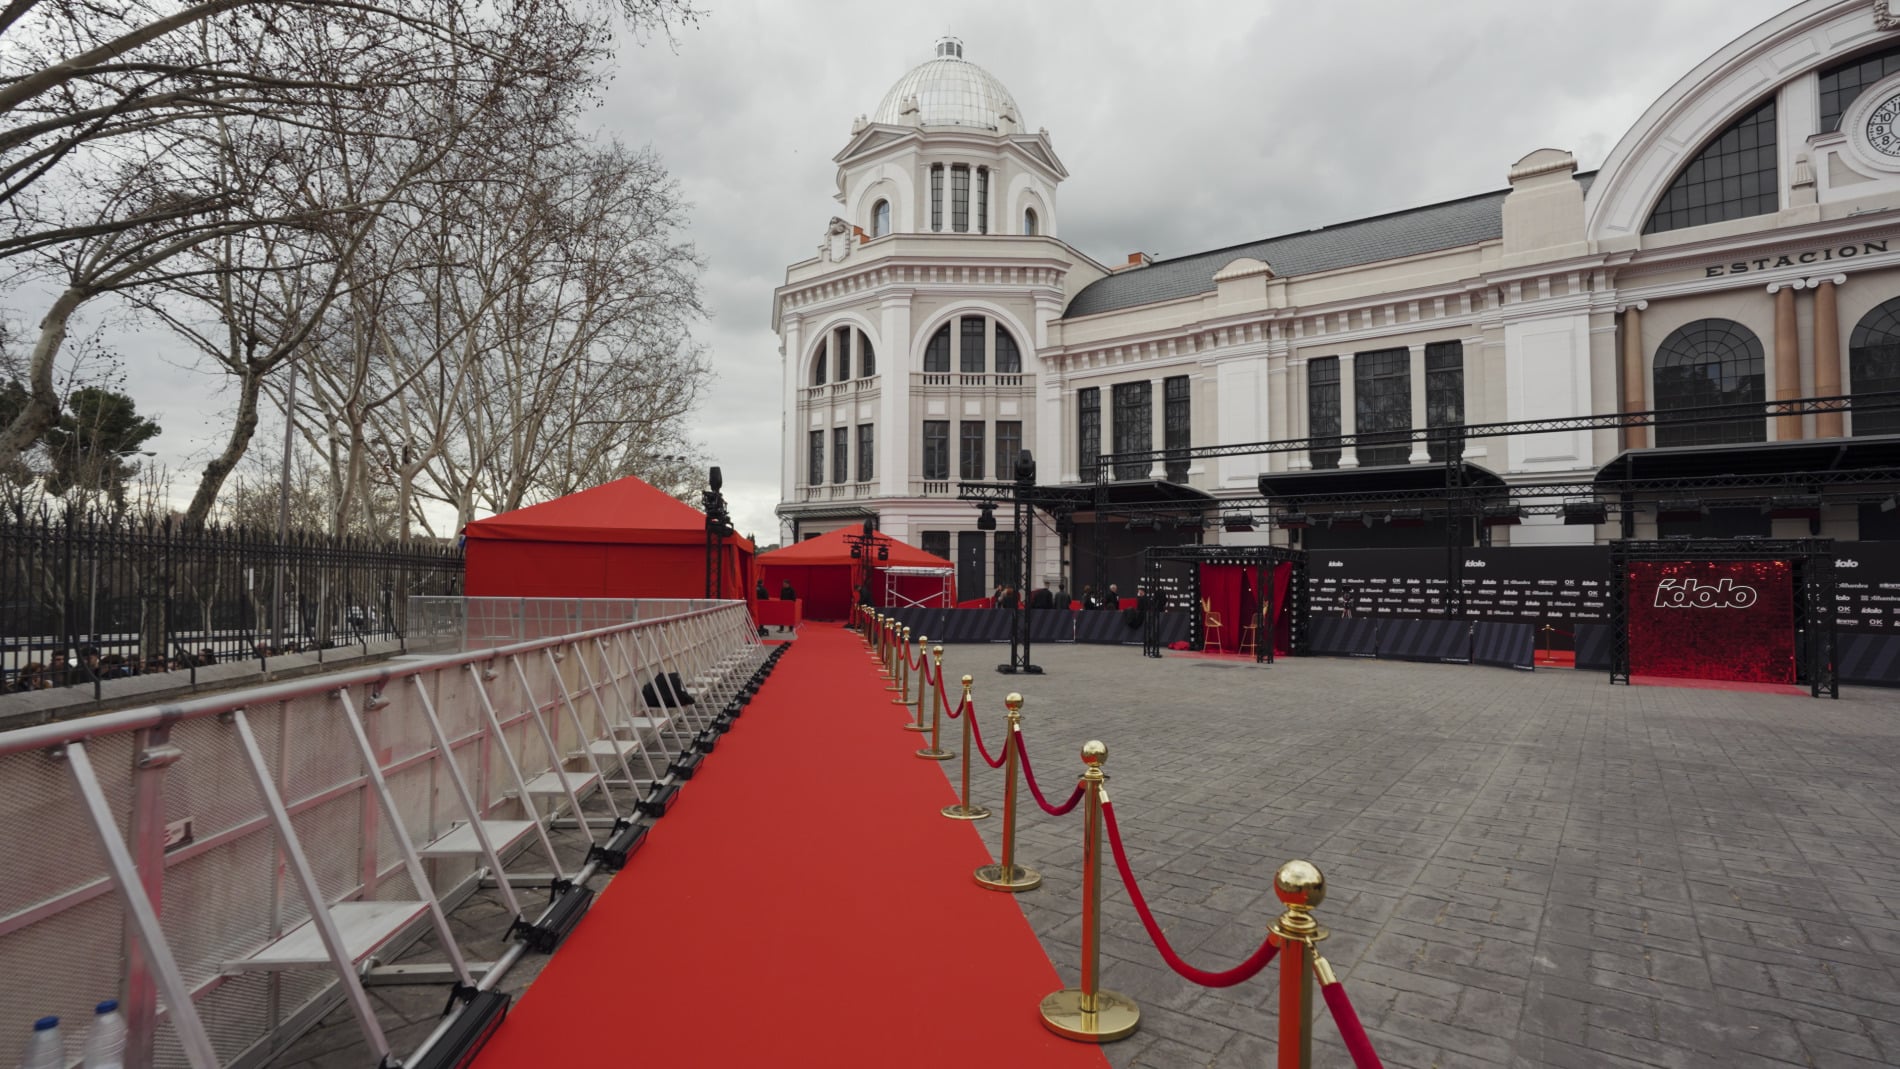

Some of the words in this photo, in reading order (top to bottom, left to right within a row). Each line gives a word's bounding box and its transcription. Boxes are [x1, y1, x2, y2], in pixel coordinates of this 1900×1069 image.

[1880, 112, 1891, 122] 10
[1876, 125, 1884, 135] 9
[1882, 136, 1890, 145] 8
[1705, 240, 1889, 278] ESTACION
[1653, 578, 1757, 608] ídolo
